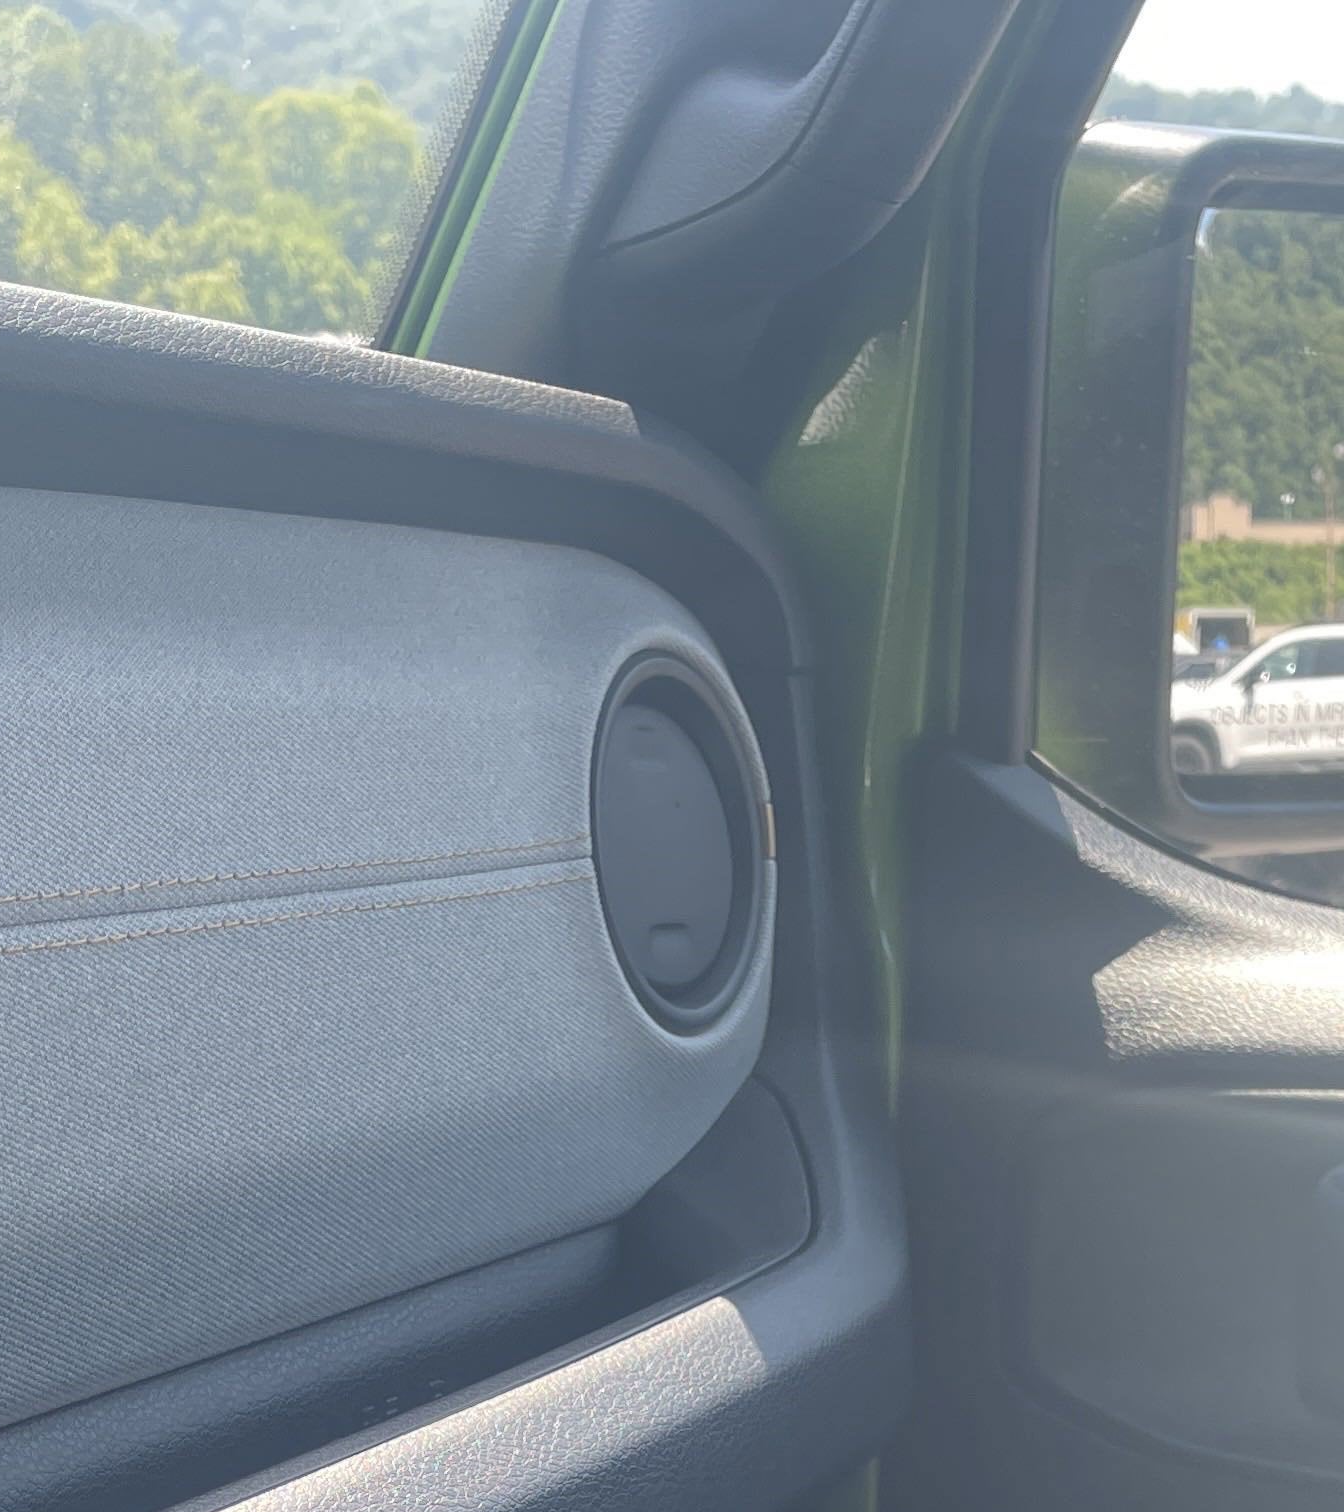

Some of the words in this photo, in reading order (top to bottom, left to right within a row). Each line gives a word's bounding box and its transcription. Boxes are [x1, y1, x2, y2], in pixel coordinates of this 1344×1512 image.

[1211, 703, 1288, 725] OBJECTS
[1294, 701, 1310, 722] IN
[1267, 727, 1309, 746] THAN
